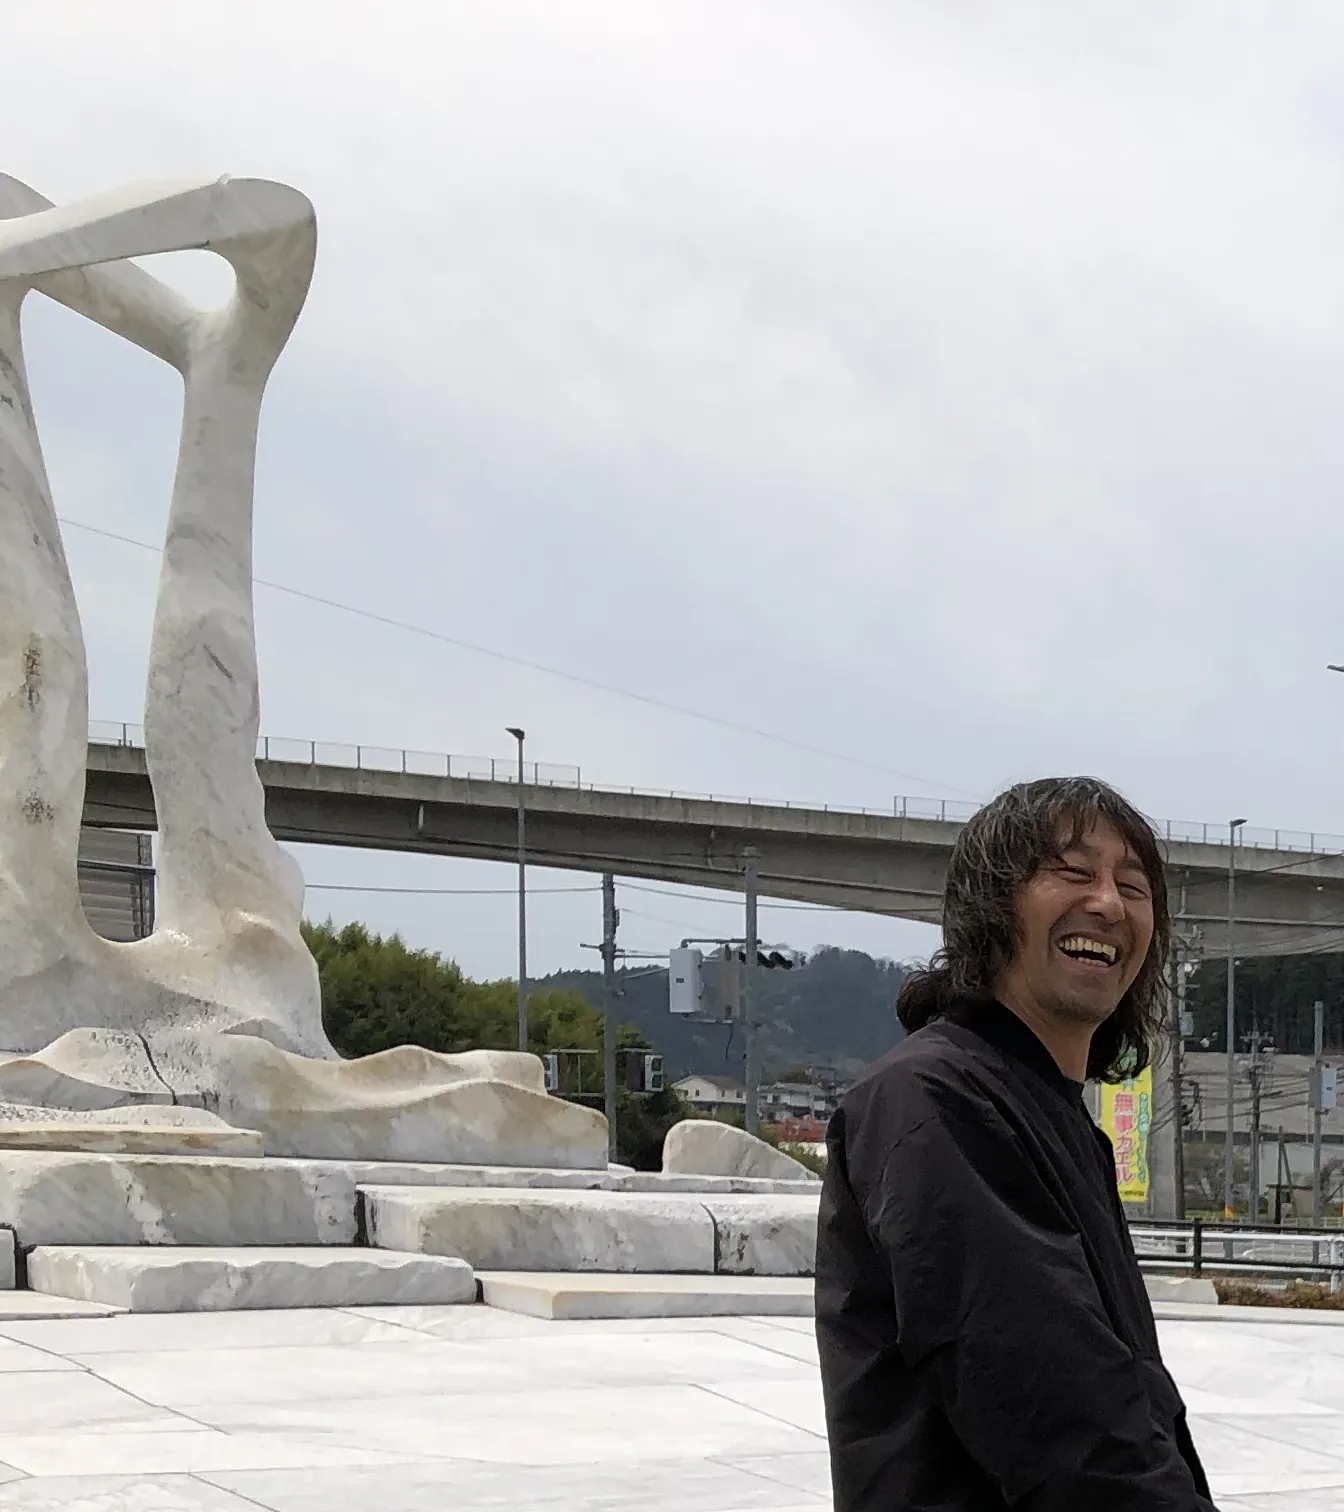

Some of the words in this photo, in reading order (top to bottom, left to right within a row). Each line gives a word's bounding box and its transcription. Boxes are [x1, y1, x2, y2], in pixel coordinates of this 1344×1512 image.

[1114, 1094, 1135, 1184] 無事カエル
